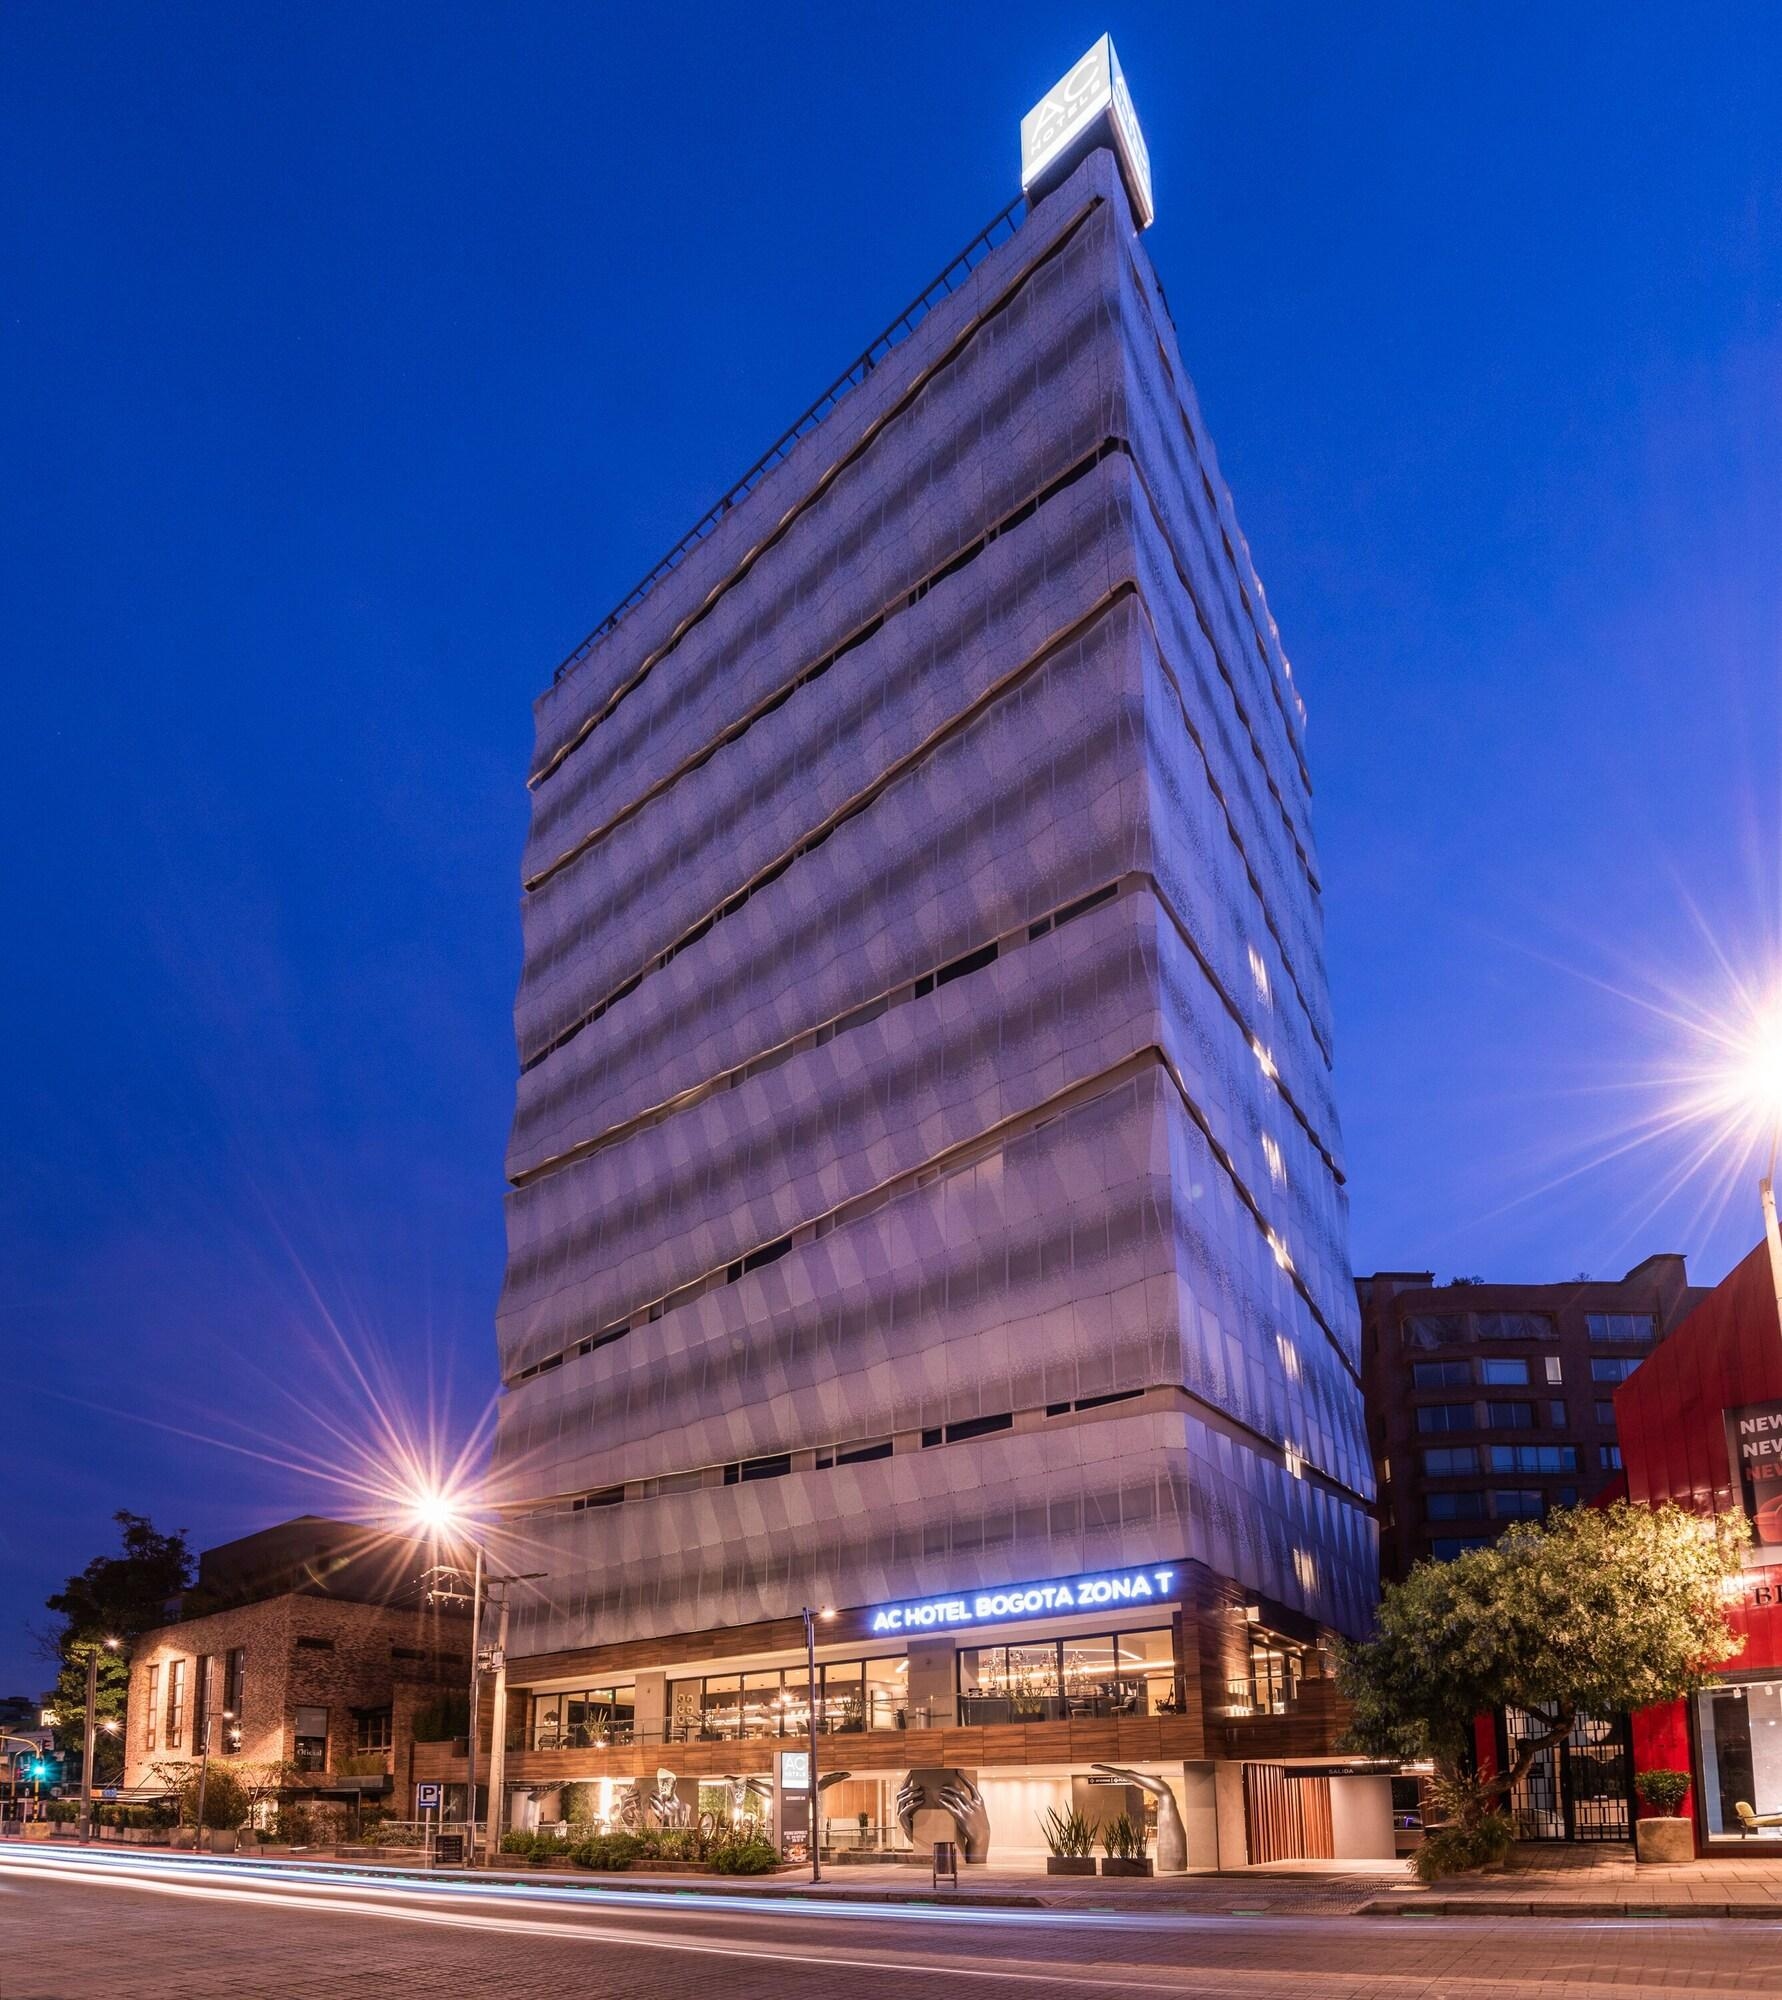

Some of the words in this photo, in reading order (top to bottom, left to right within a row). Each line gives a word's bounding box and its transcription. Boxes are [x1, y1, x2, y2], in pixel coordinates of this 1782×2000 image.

[1031, 55, 1099, 143] AC
[1031, 79, 1100, 156] HOTELS
[873, 1610, 902, 1631] AC
[906, 1602, 972, 1626] HOTEL
[976, 1587, 1075, 1618] BOGOTA
[1078, 1576, 1153, 1605] ZONA
[1155, 1572, 1173, 1594] T
[784, 1755, 806, 1771] AC
[423, 1787, 435, 1800] P
